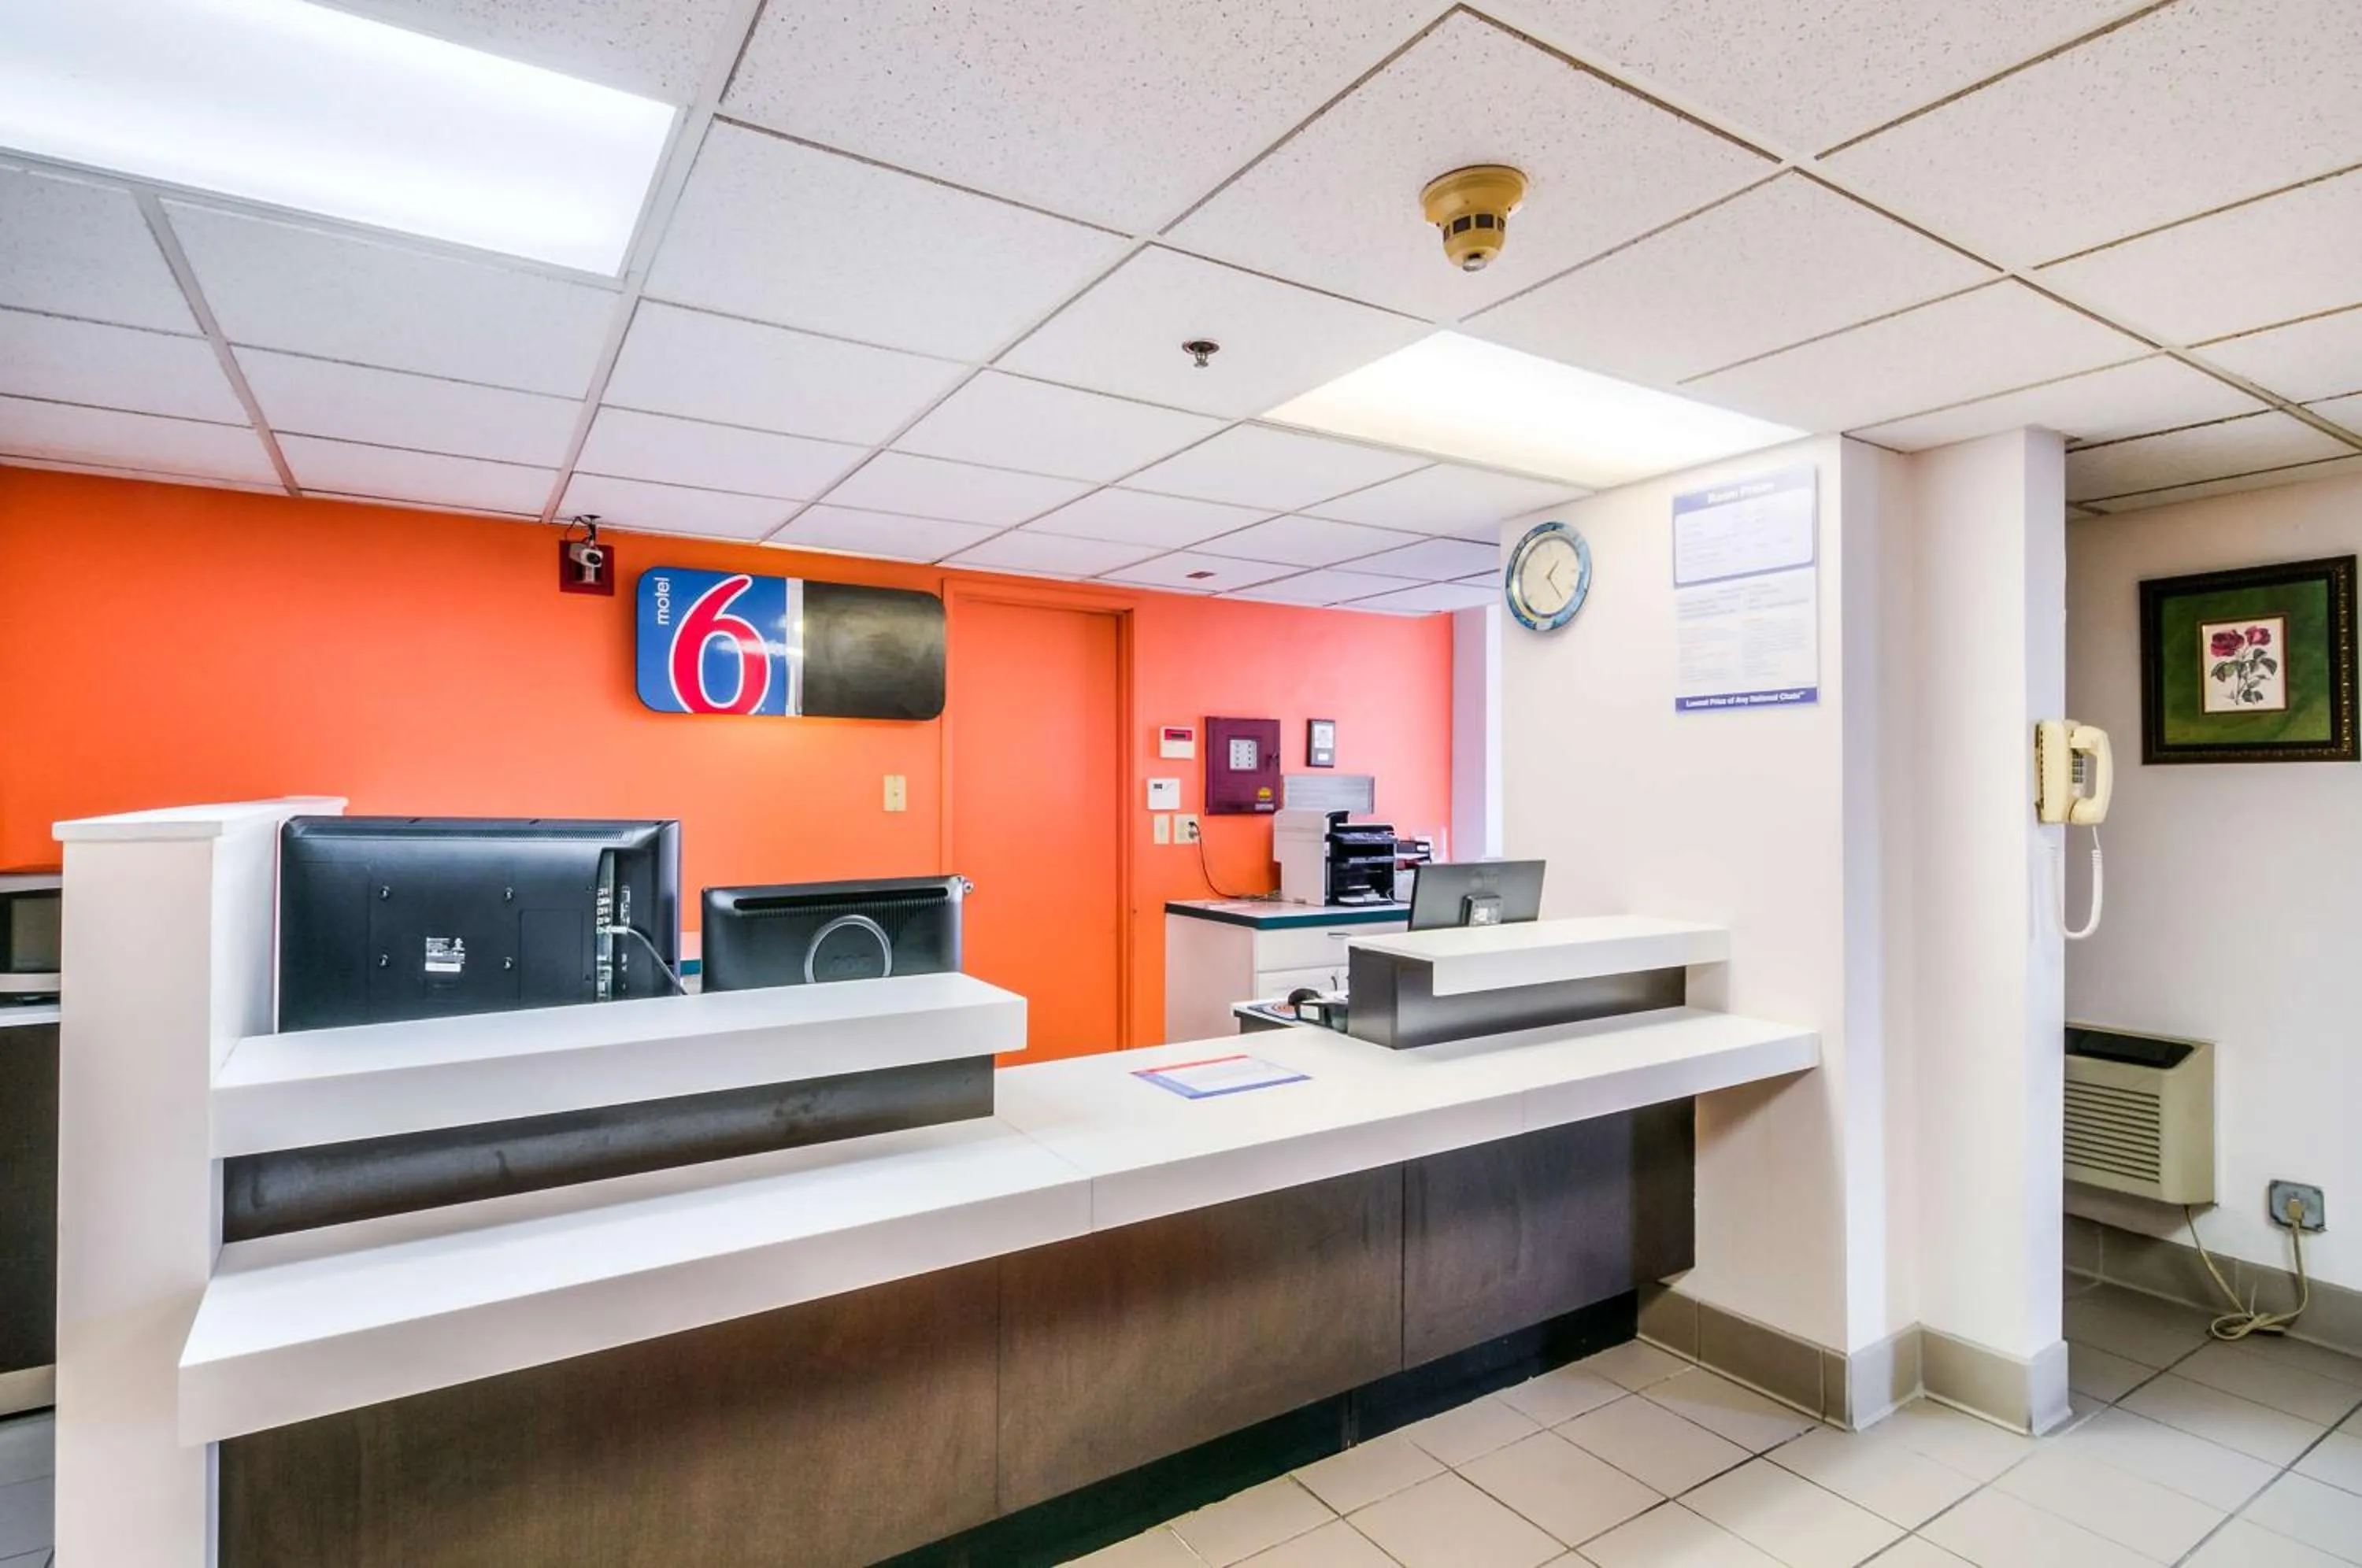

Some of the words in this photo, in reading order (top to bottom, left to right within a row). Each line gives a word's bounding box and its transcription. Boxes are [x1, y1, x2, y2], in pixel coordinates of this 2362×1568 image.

[653, 577, 670, 626] motel
[668, 574, 771, 713] 6
[1686, 698, 1709, 708] Lowest
[1709, 697, 1727, 706] Price
[1727, 697, 1734, 705] of
[1735, 696, 1749, 705] Any
[1749, 693, 1778, 703] National
